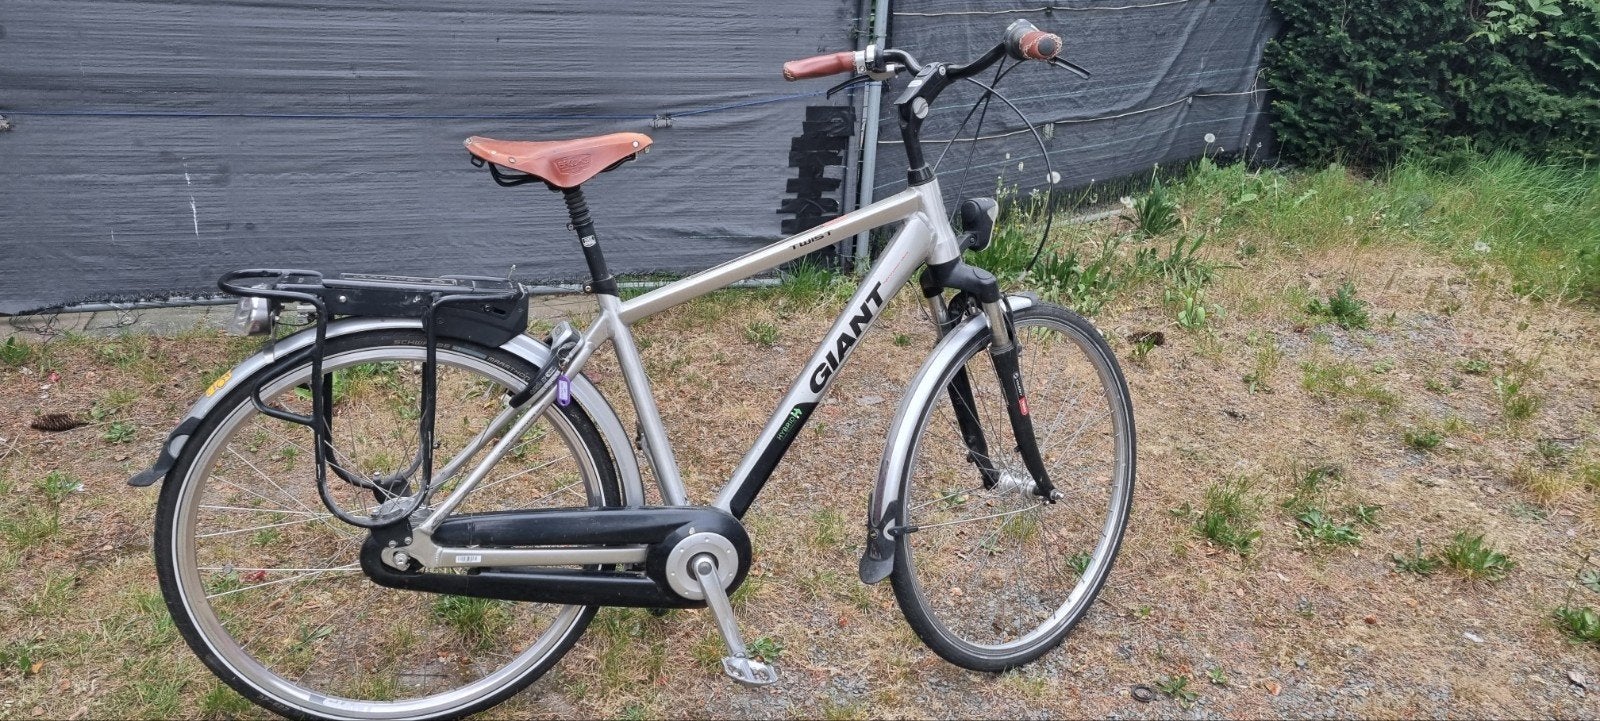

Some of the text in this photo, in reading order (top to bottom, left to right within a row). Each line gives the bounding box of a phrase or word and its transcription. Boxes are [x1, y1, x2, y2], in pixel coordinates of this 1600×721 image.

[791, 231, 832, 250] TWIST
[809, 281, 884, 394] GIANT
[487, 355, 532, 382] MARATHON
[776, 416, 796, 441] HYBRID
